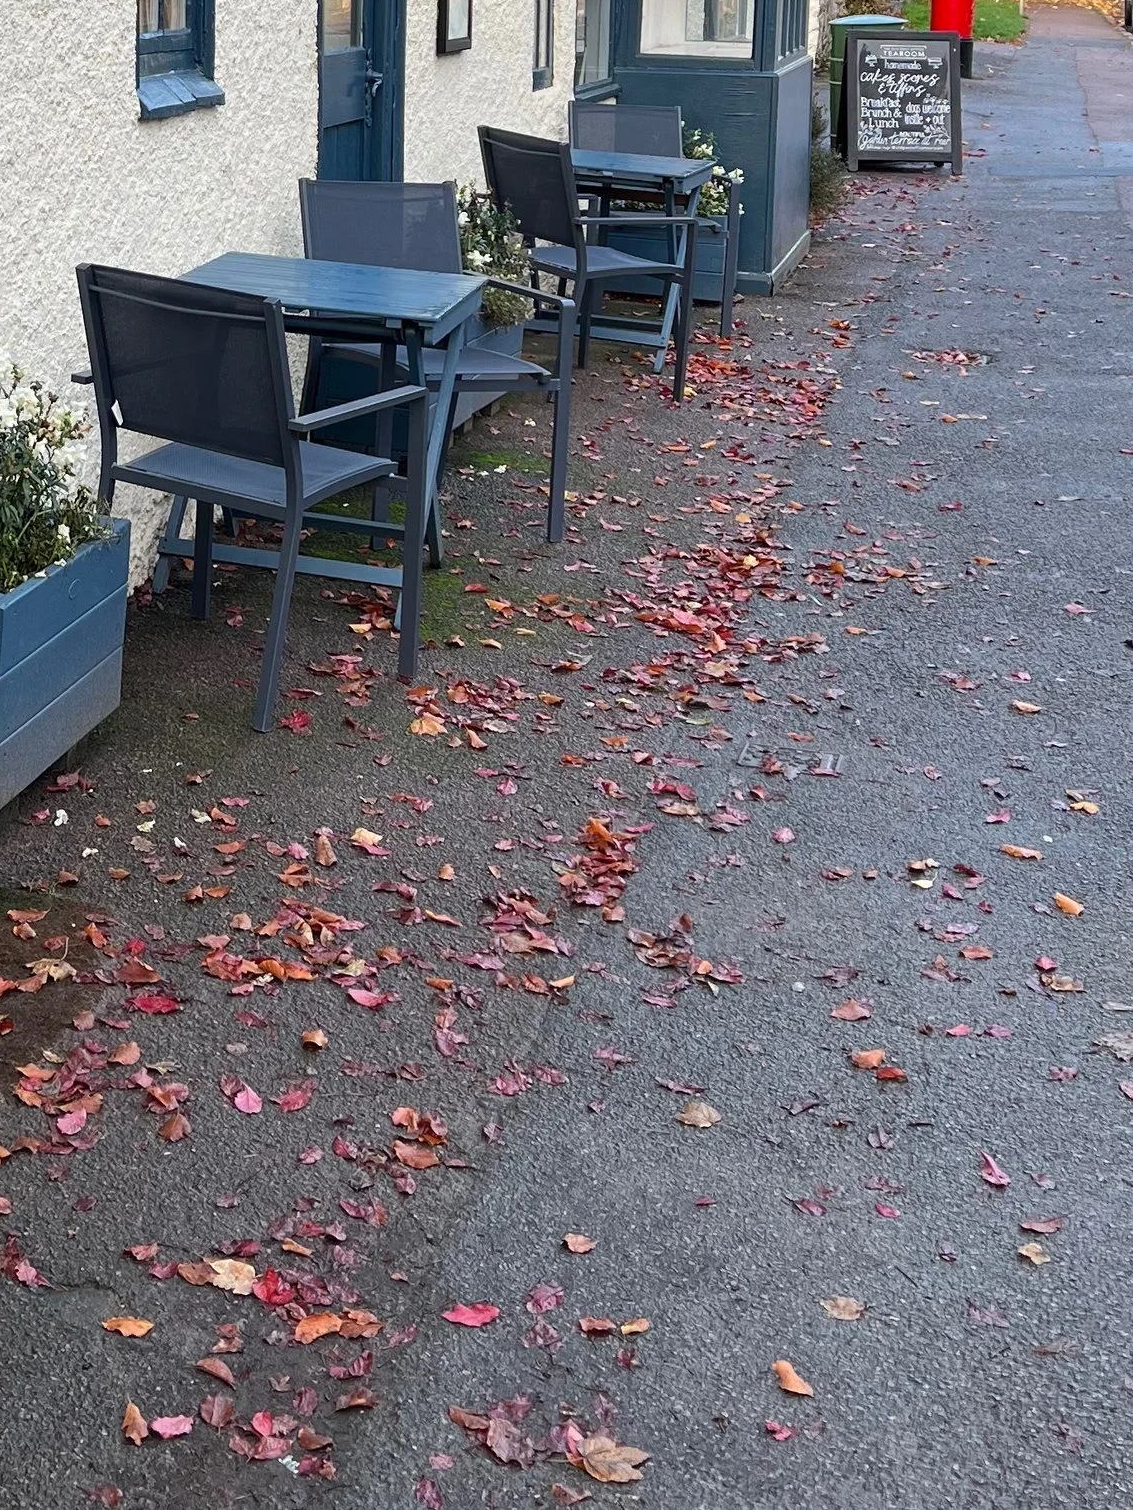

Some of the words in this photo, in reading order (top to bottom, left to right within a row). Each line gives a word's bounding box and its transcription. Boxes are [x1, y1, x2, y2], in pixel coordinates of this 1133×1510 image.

[860, 68, 895, 84] cakes
[898, 73, 940, 87] scones
[860, 108, 892, 118] Brunch
[893, 108, 903, 118] &
[905, 102, 921, 113] dogs
[922, 102, 951, 114] welcome
[868, 118, 899, 128] Lunch
[933, 114, 946, 124] out
